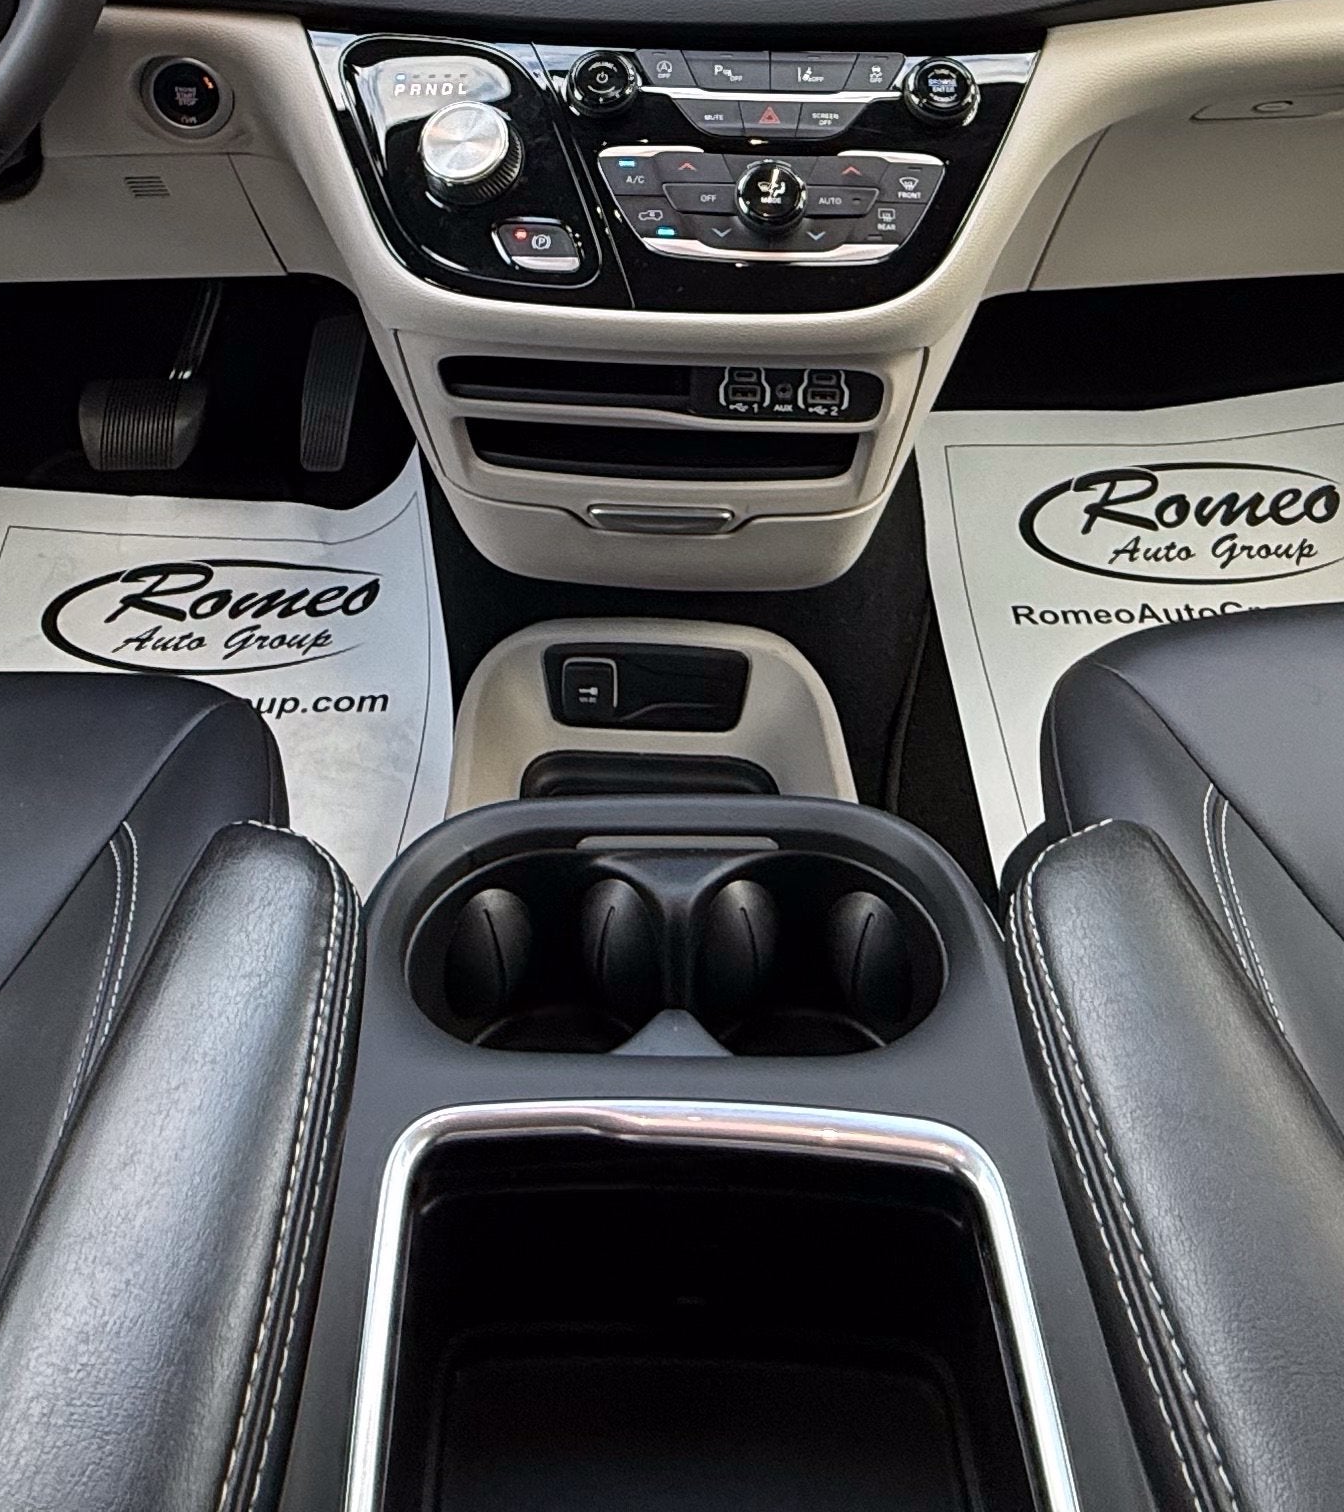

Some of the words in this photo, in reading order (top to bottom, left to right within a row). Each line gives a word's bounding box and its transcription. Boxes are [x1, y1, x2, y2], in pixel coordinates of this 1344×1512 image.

[869, 76, 883, 84] OFF
[625, 174, 645, 185] A/C
[700, 194, 717, 203] OFF
[897, 190, 922, 200] FRONT
[818, 196, 842, 206] AUTO
[876, 223, 896, 231] REAR
[752, 403, 758, 413] 1
[773, 404, 794, 412] AUX
[830, 406, 839, 416] 2
[1072, 467, 1341, 535] Romeo
[1107, 534, 1196, 565] Auto
[1211, 532, 1320, 570] Group
[105, 561, 382, 623] Romeo
[111, 625, 208, 654] Auto
[222, 624, 334, 660] Group
[255, 693, 390, 720] up.com
